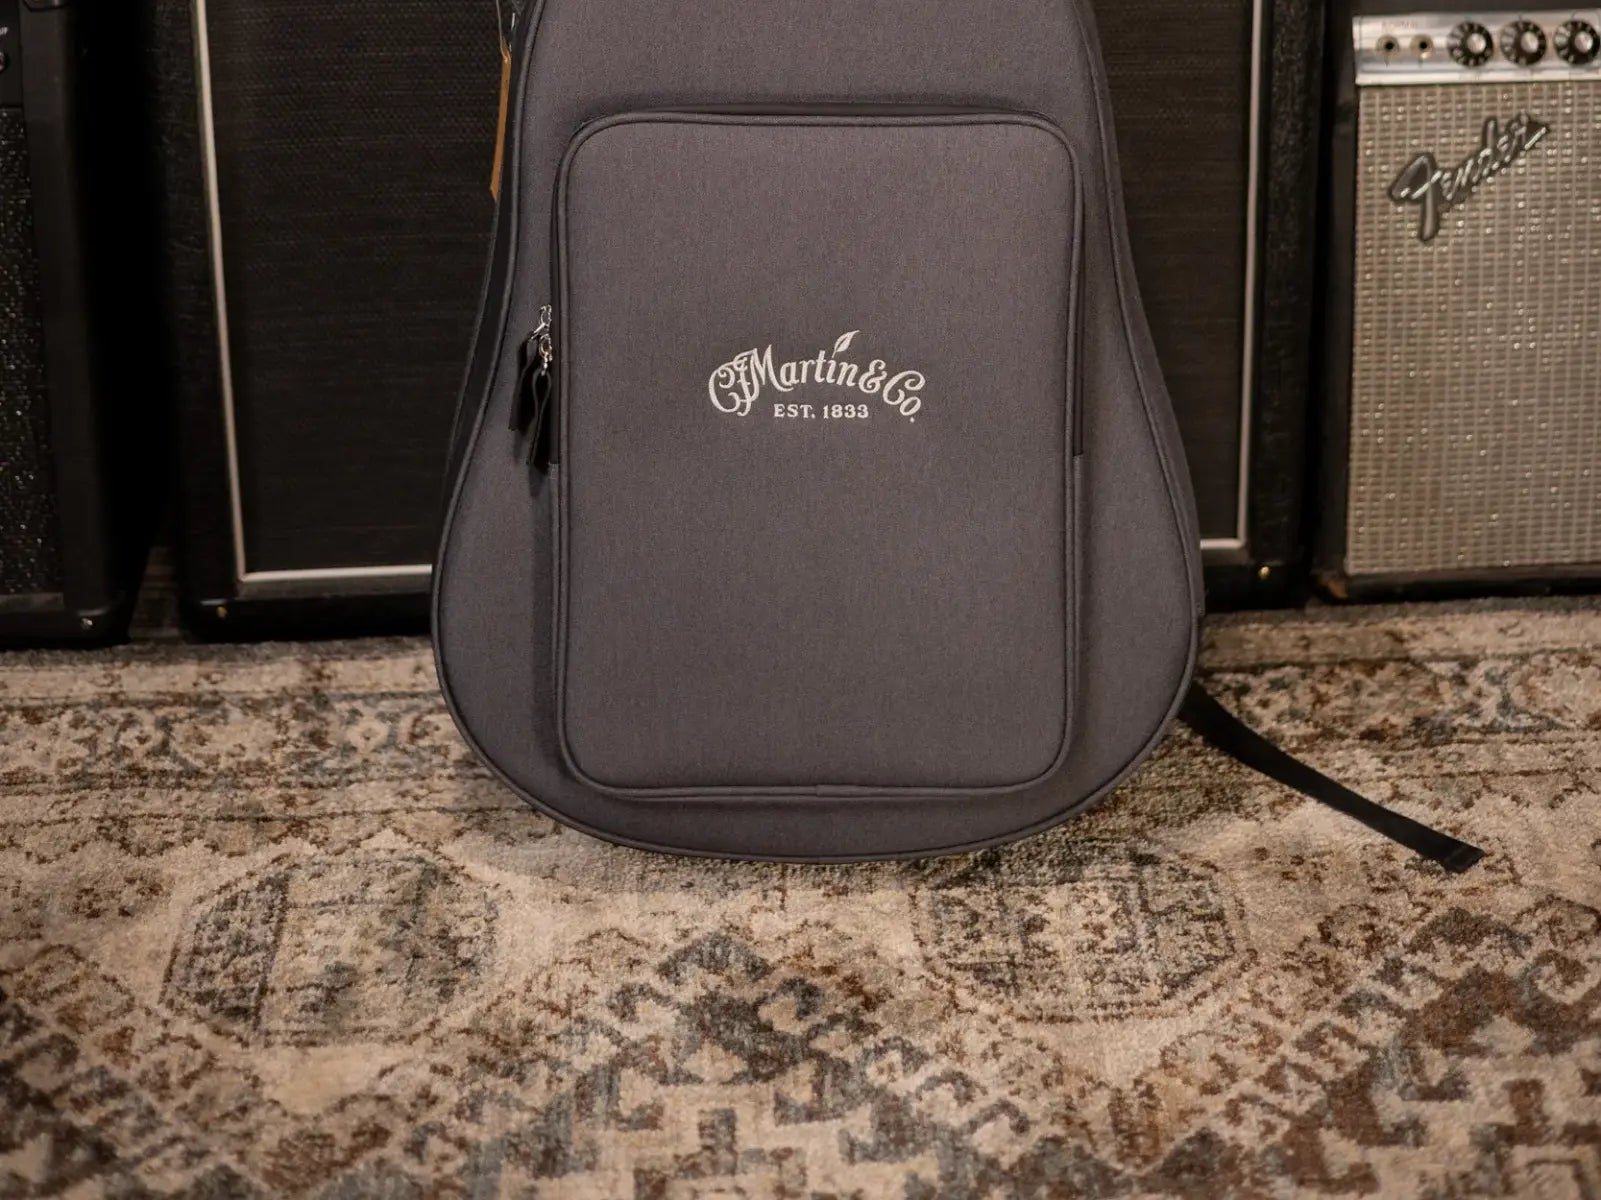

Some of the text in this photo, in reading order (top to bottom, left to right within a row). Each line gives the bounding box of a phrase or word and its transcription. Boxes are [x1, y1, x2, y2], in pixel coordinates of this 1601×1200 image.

[1389, 111, 1549, 241] Fender
[773, 404, 869, 419] EST. 1833
